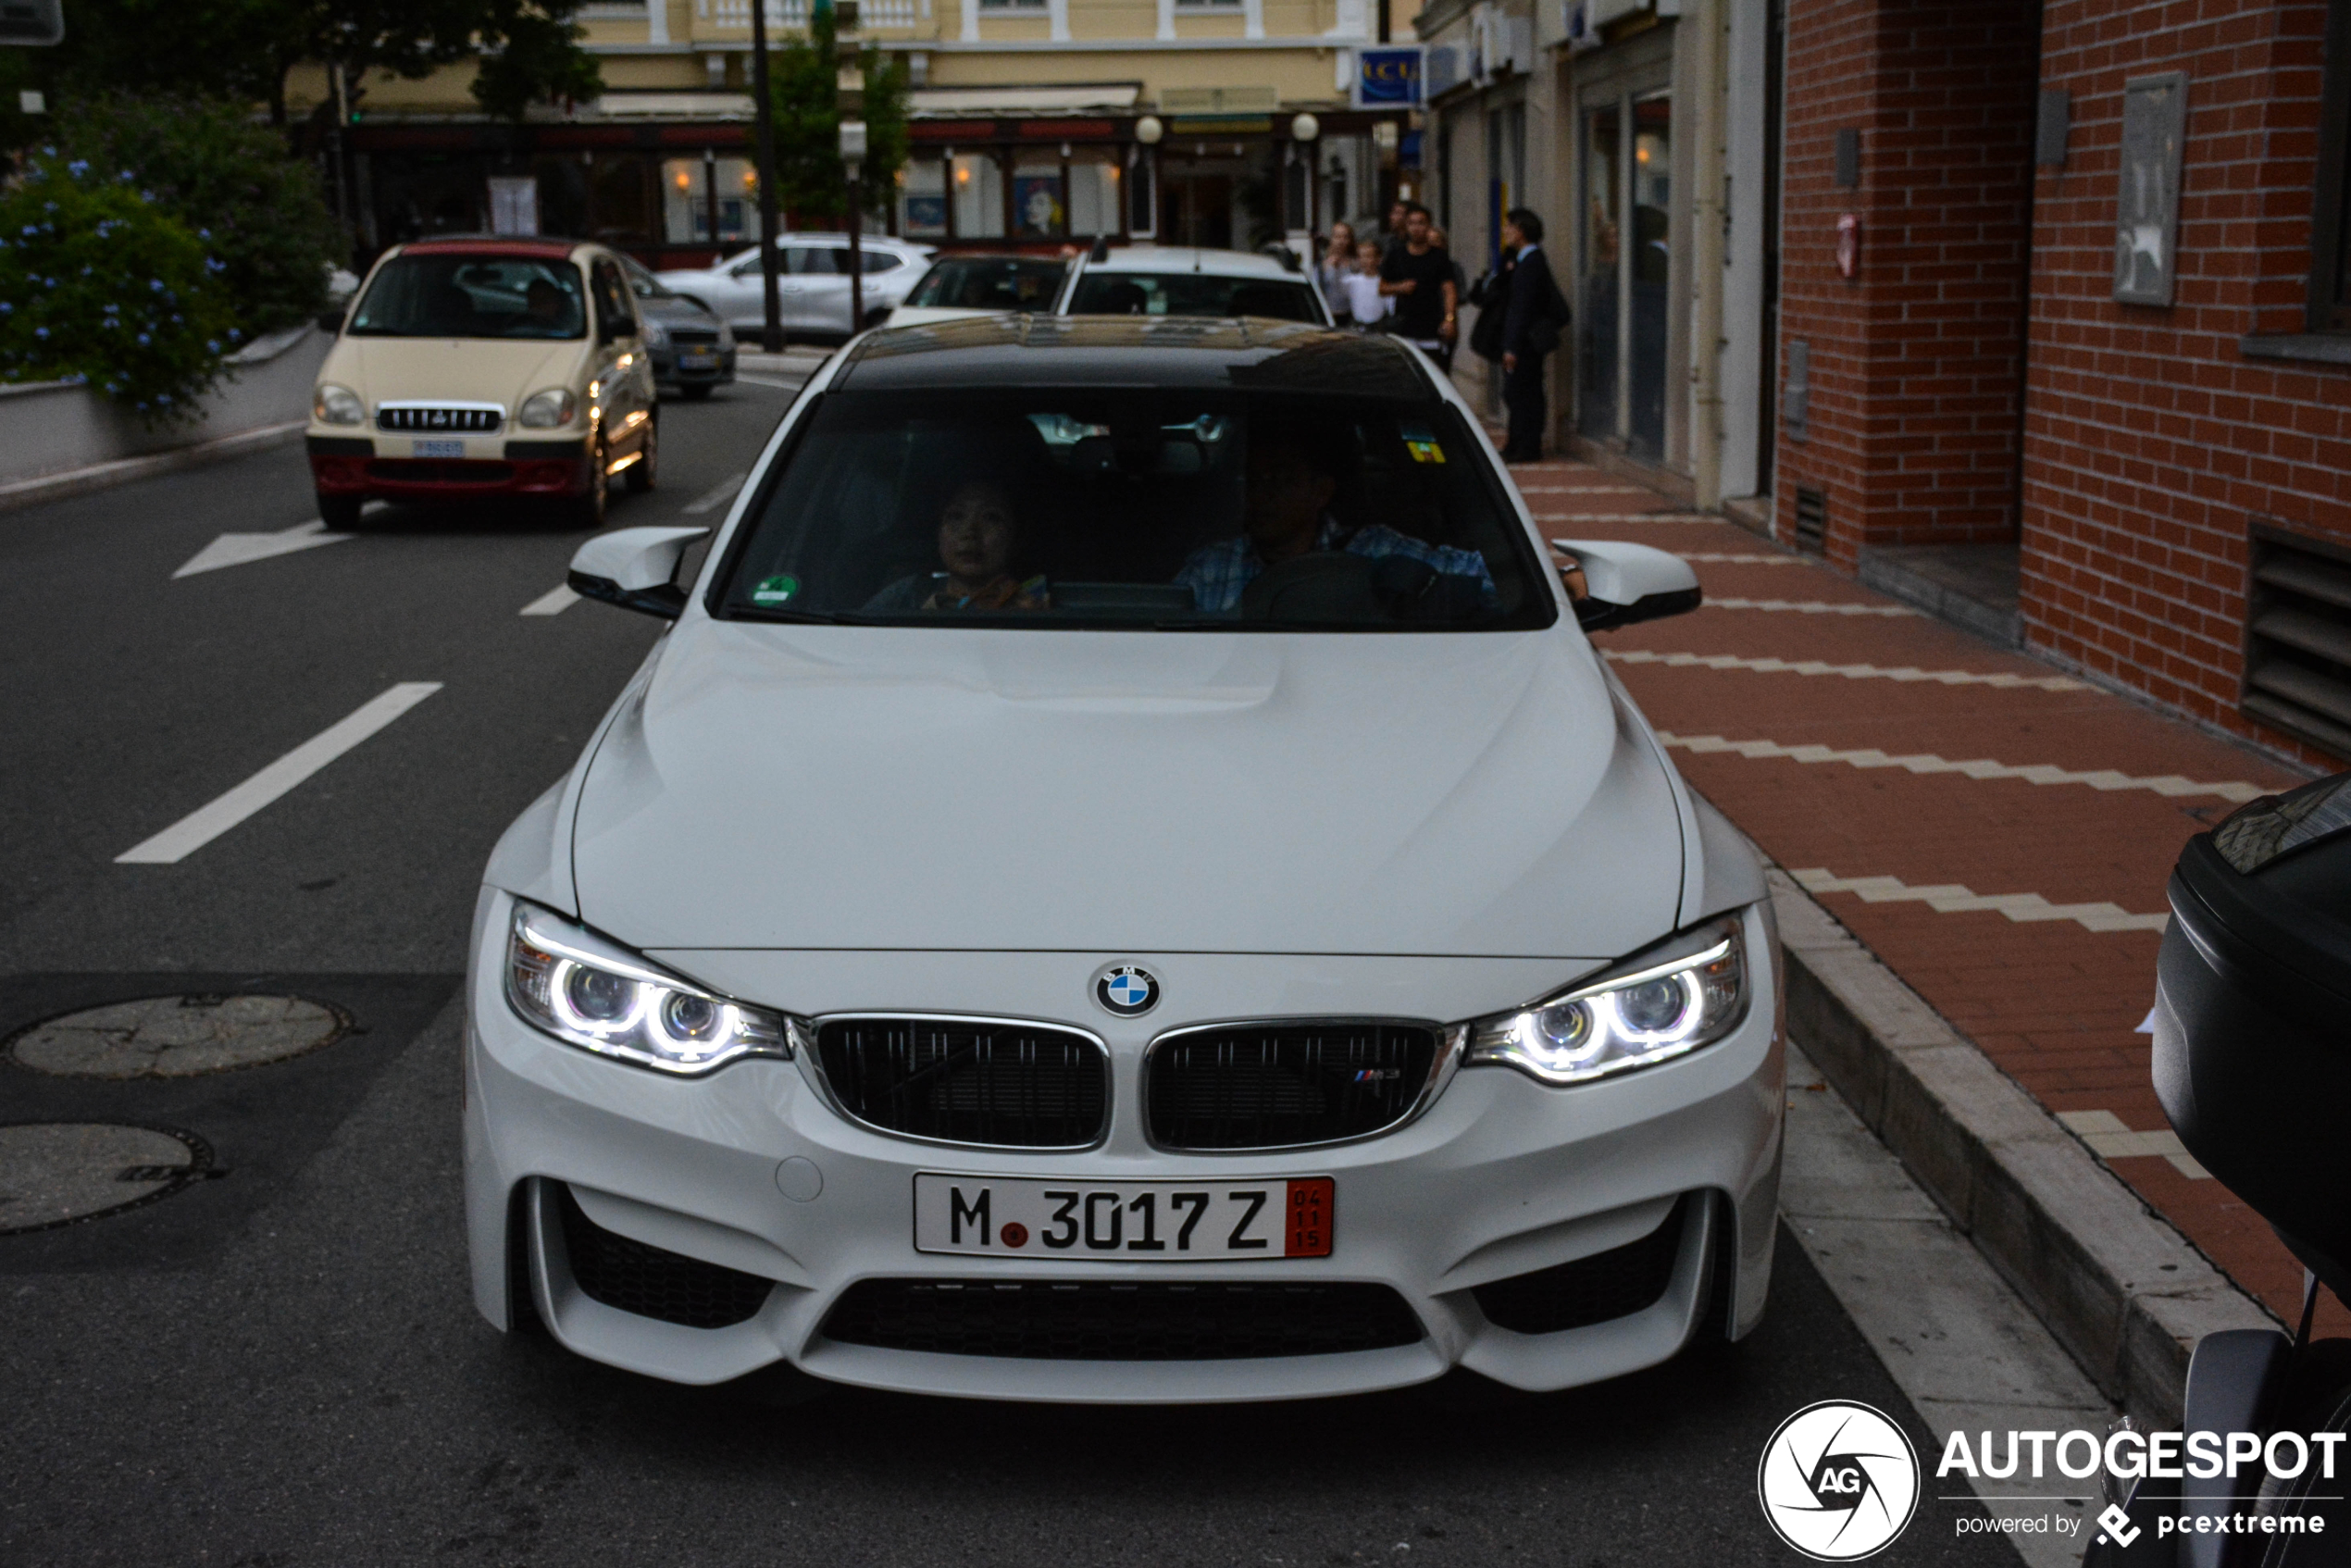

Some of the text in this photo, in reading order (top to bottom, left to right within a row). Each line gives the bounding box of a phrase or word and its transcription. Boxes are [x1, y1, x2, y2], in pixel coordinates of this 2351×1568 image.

[1102, 965, 1154, 982] BMW
[1294, 1189, 1320, 1206] 04
[951, 1187, 1267, 1251] M 3017 Z
[1296, 1210, 1319, 1227] 11
[1296, 1230, 1320, 1247] 15
